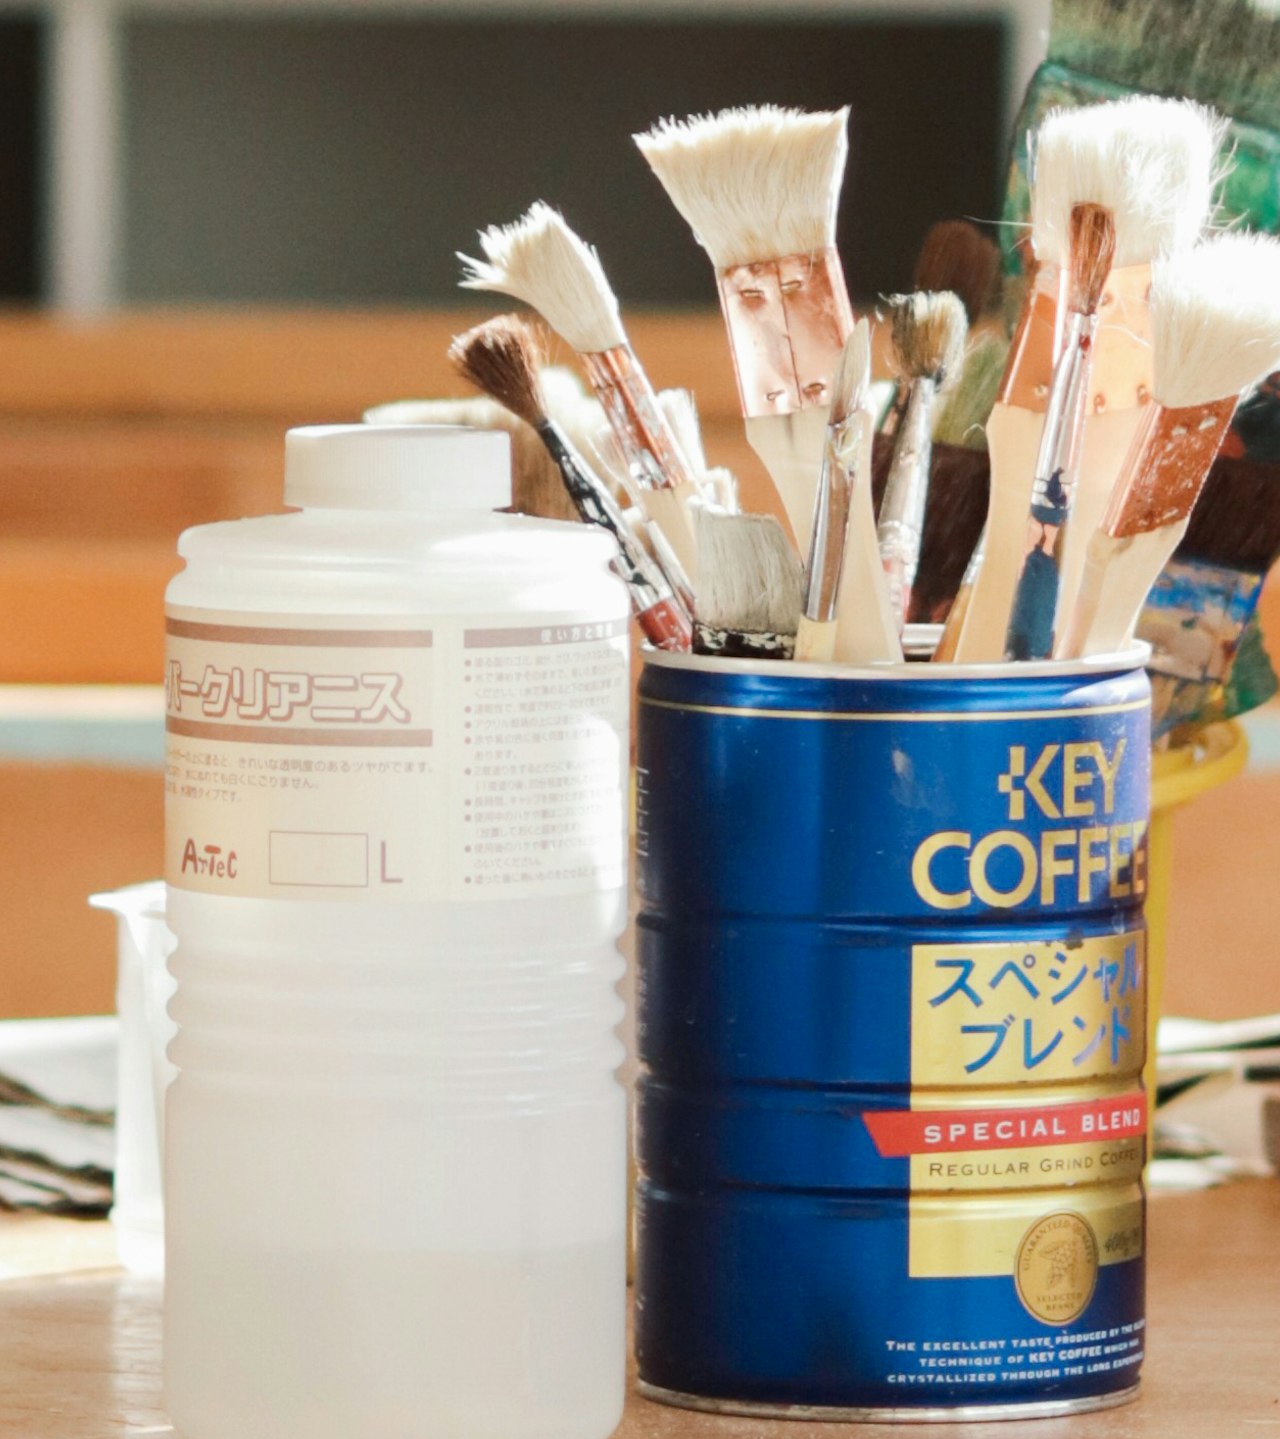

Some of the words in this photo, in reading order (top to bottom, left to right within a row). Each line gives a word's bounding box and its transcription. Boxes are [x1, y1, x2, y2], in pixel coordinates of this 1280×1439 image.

[998, 737, 1128, 821] KEY
[380, 840, 403, 883] L
[911, 819, 1149, 910] COFFEE
[928, 940, 1138, 1008] スペシャル
[960, 1006, 1131, 1075] ブレンド
[923, 1118, 1066, 1143] SPECIAL
[1081, 1108, 1141, 1133] BLEND
[929, 1161, 1030, 1177] REGULAR
[1040, 1156, 1093, 1173] GRIND
[886, 1340, 916, 1352] THE
[923, 1340, 1006, 1352] EXCELLENT
[1012, 1337, 1051, 1349] TASTE
[1055, 1330, 1107, 1345] PRODUCED
[1109, 1328, 1120, 1338] BY
[919, 1356, 1002, 1368] TECHNIQUE
[1007, 1355, 1024, 1364] OF
[1029, 1351, 1055, 1364] KEY
[1058, 1345, 1102, 1360] COFFEE
[886, 1373, 997, 1384] CRYSTALLIZED
[1001, 1368, 1060, 1381] THROUGH
[1064, 1365, 1084, 1376] THE
